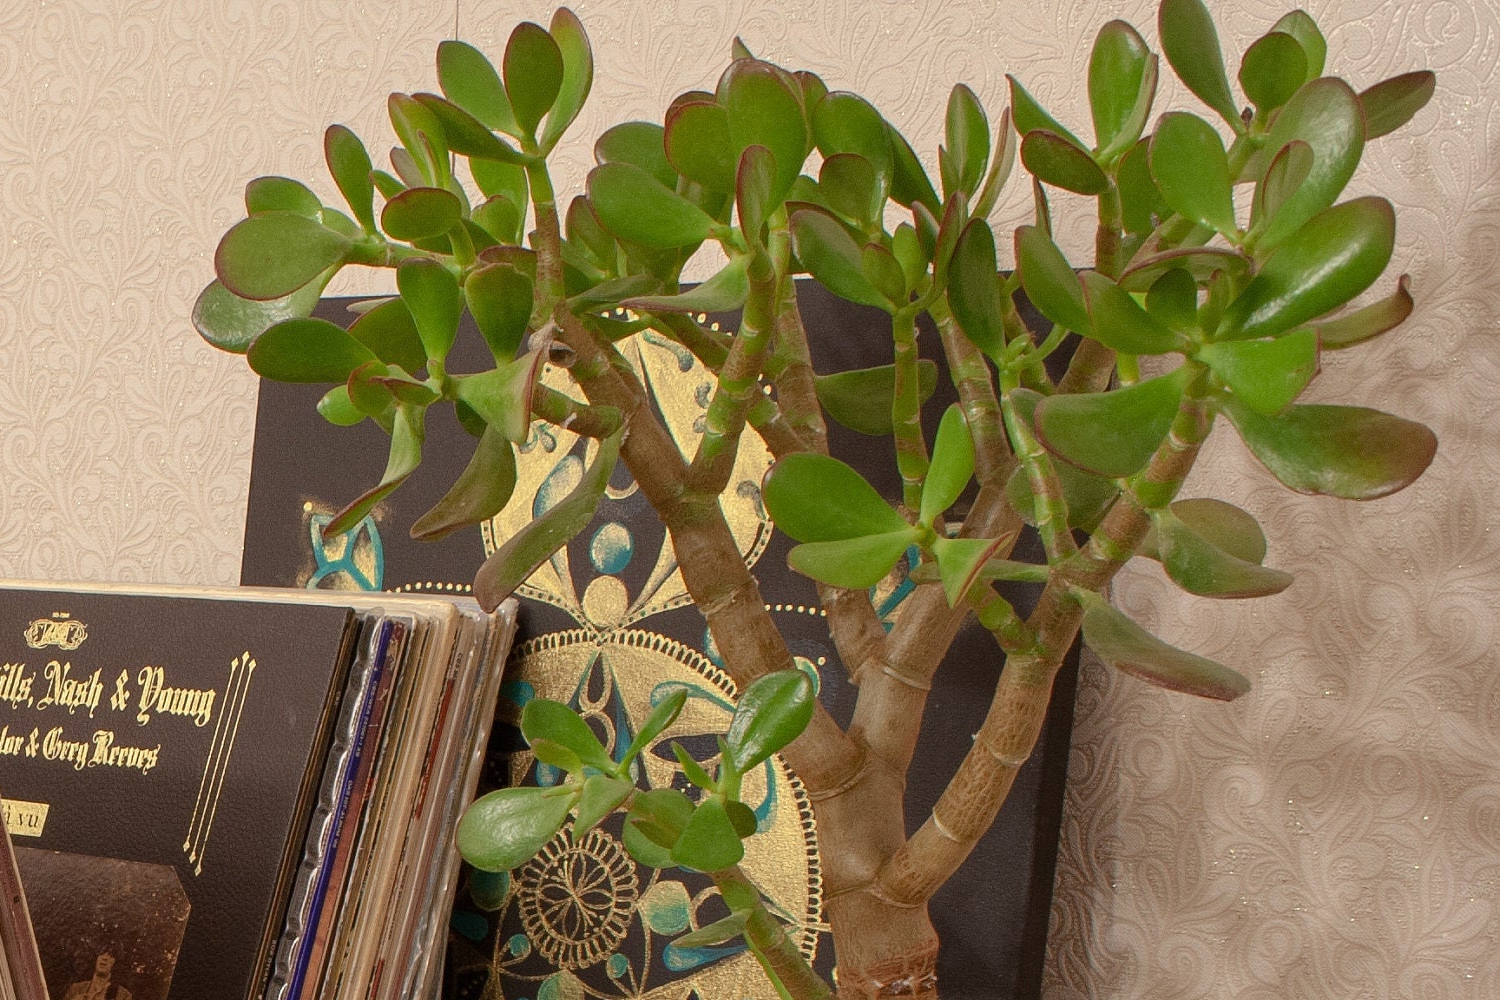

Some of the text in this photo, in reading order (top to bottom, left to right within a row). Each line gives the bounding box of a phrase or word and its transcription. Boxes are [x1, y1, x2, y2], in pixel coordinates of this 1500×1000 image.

[37, 660, 103, 718] Nash
[111, 669, 130, 712] &
[137, 666, 216, 727] Young
[25, 727, 40, 758] &
[43, 726, 88, 771] Greg
[88, 730, 161, 775] Reeves
